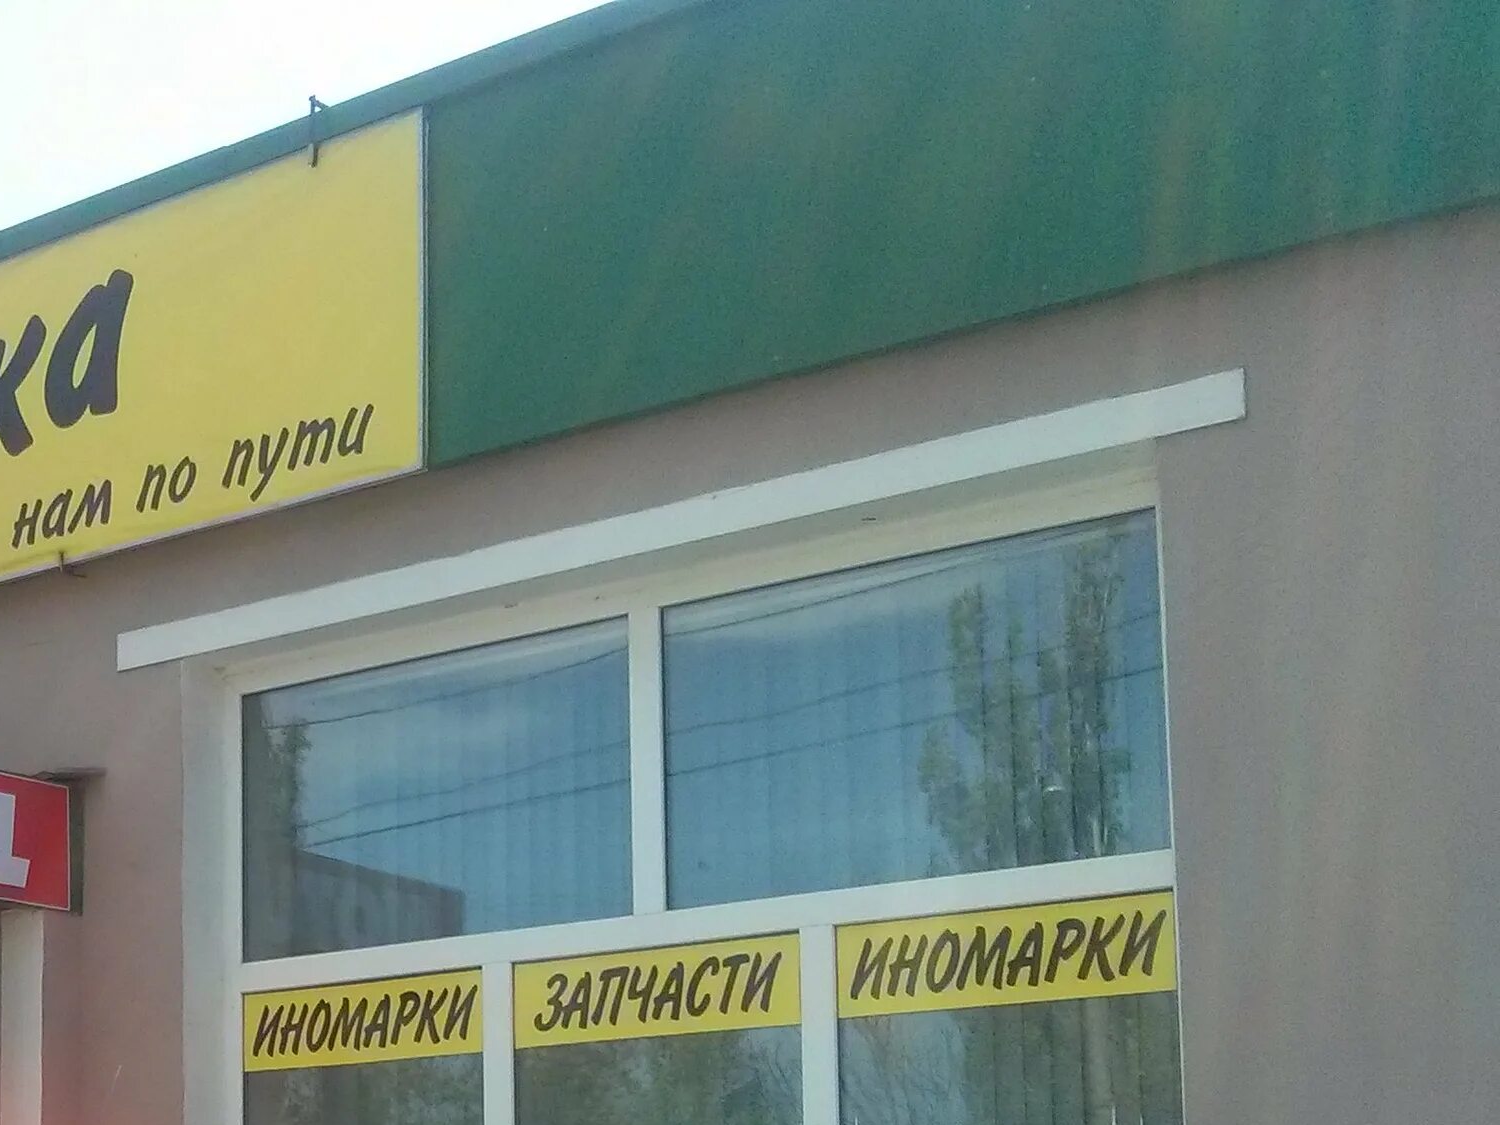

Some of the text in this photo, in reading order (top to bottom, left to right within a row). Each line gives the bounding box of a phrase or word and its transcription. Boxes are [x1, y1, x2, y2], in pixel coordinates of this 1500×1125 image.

[11, 478, 112, 548] нам
[135, 455, 197, 514] по
[221, 403, 375, 501] пути
[533, 951, 784, 1033] ЗАПЧАСТИ
[848, 908, 1169, 1001] ИНОМАРКИ
[252, 984, 479, 1059] ИНОМАРКИ
